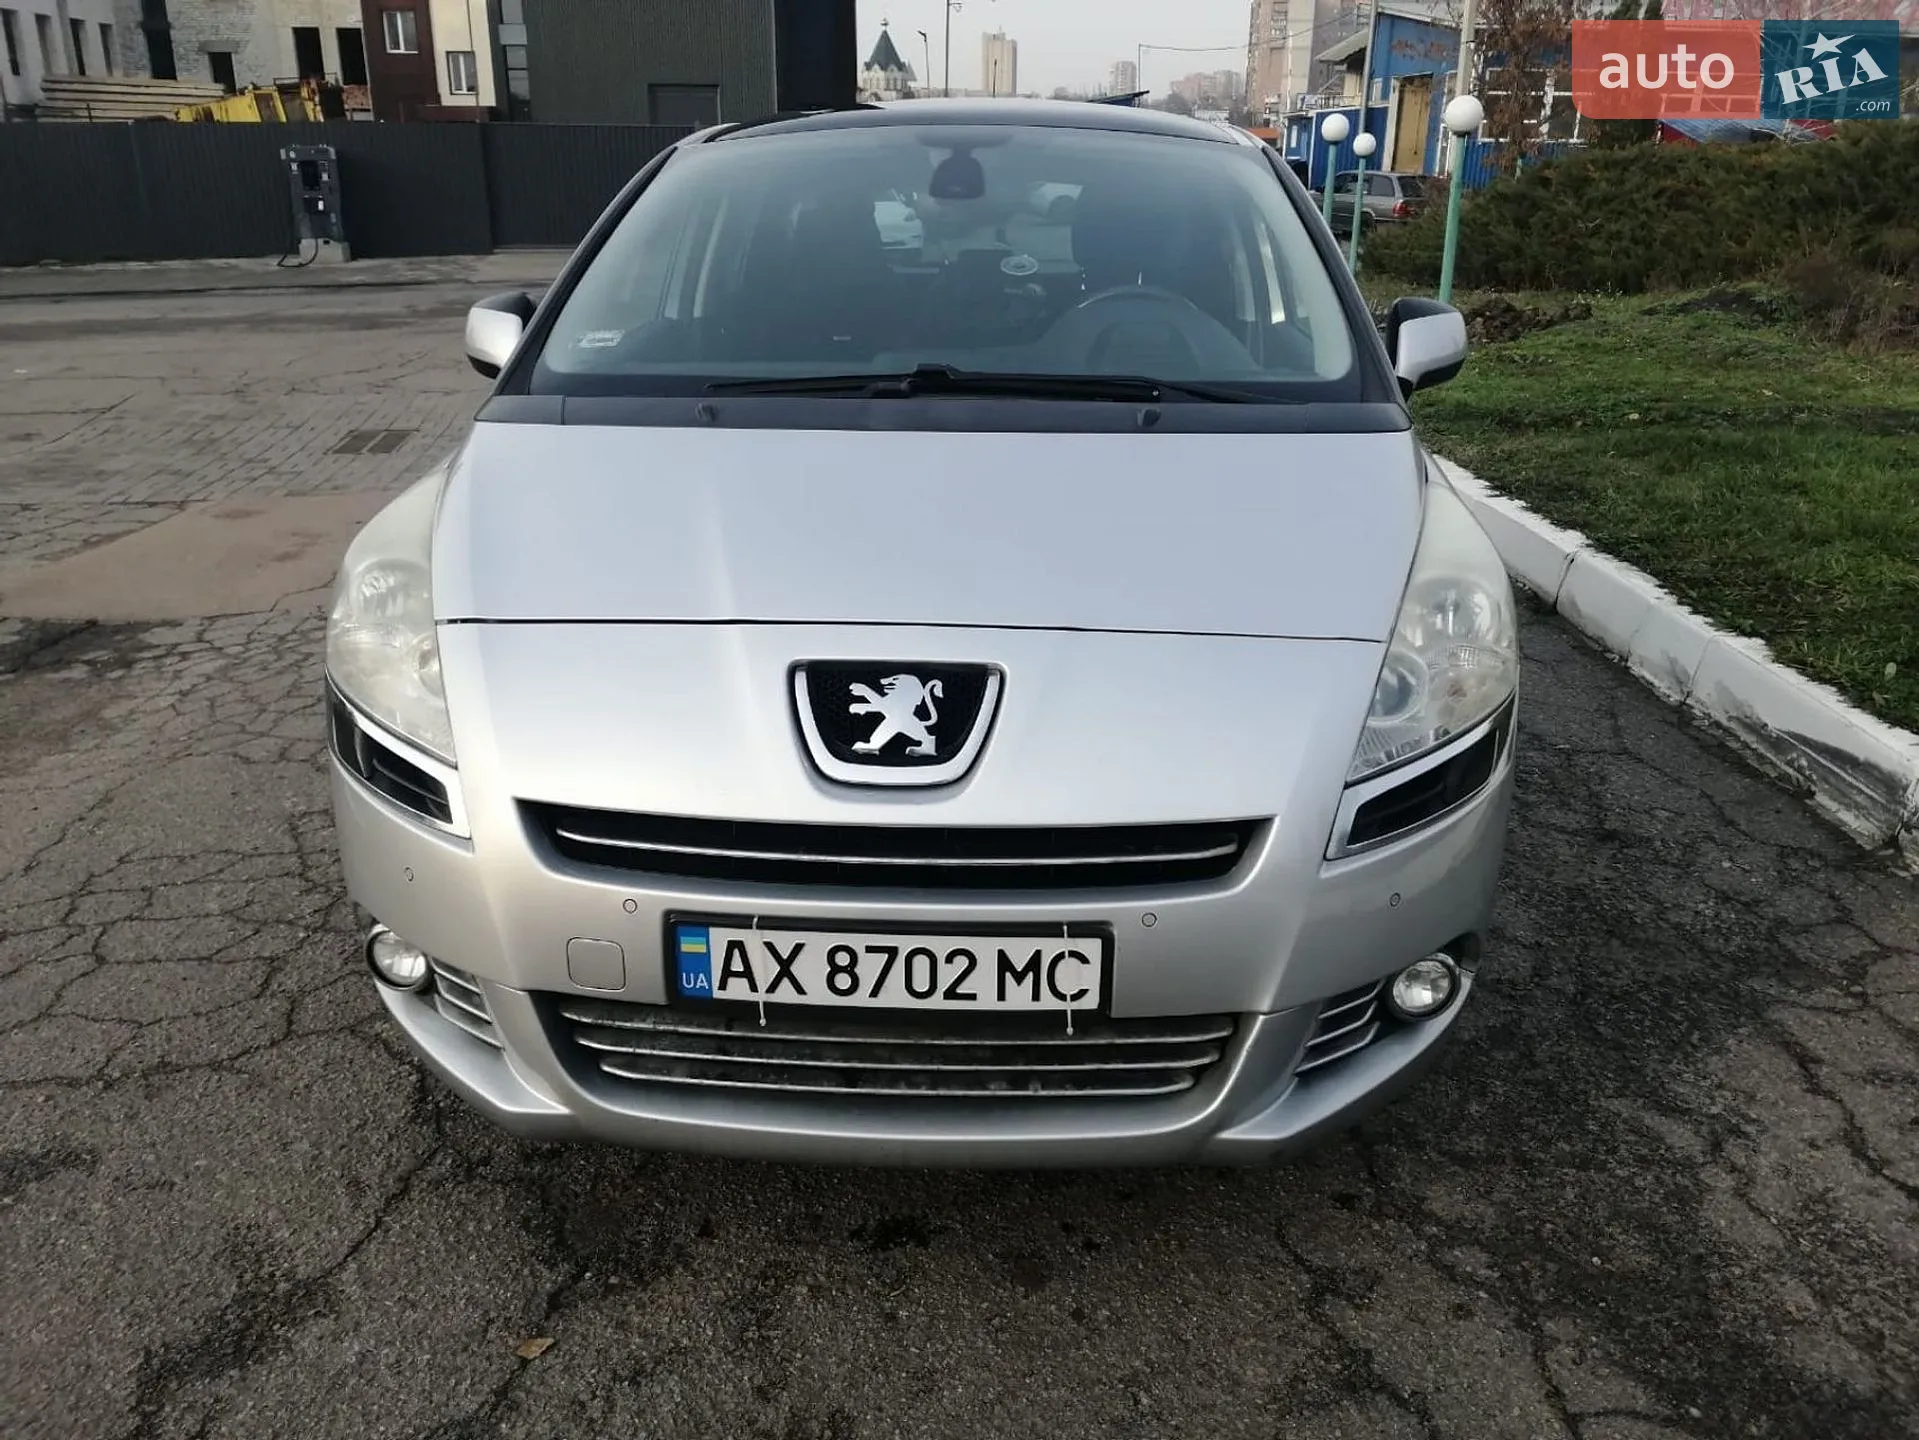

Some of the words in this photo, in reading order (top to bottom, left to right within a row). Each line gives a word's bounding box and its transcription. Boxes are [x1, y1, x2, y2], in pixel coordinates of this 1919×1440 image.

[682, 971, 709, 990] UA
[717, 939, 808, 996] AX
[825, 943, 978, 1002] 8702
[996, 948, 1092, 1003] MC
